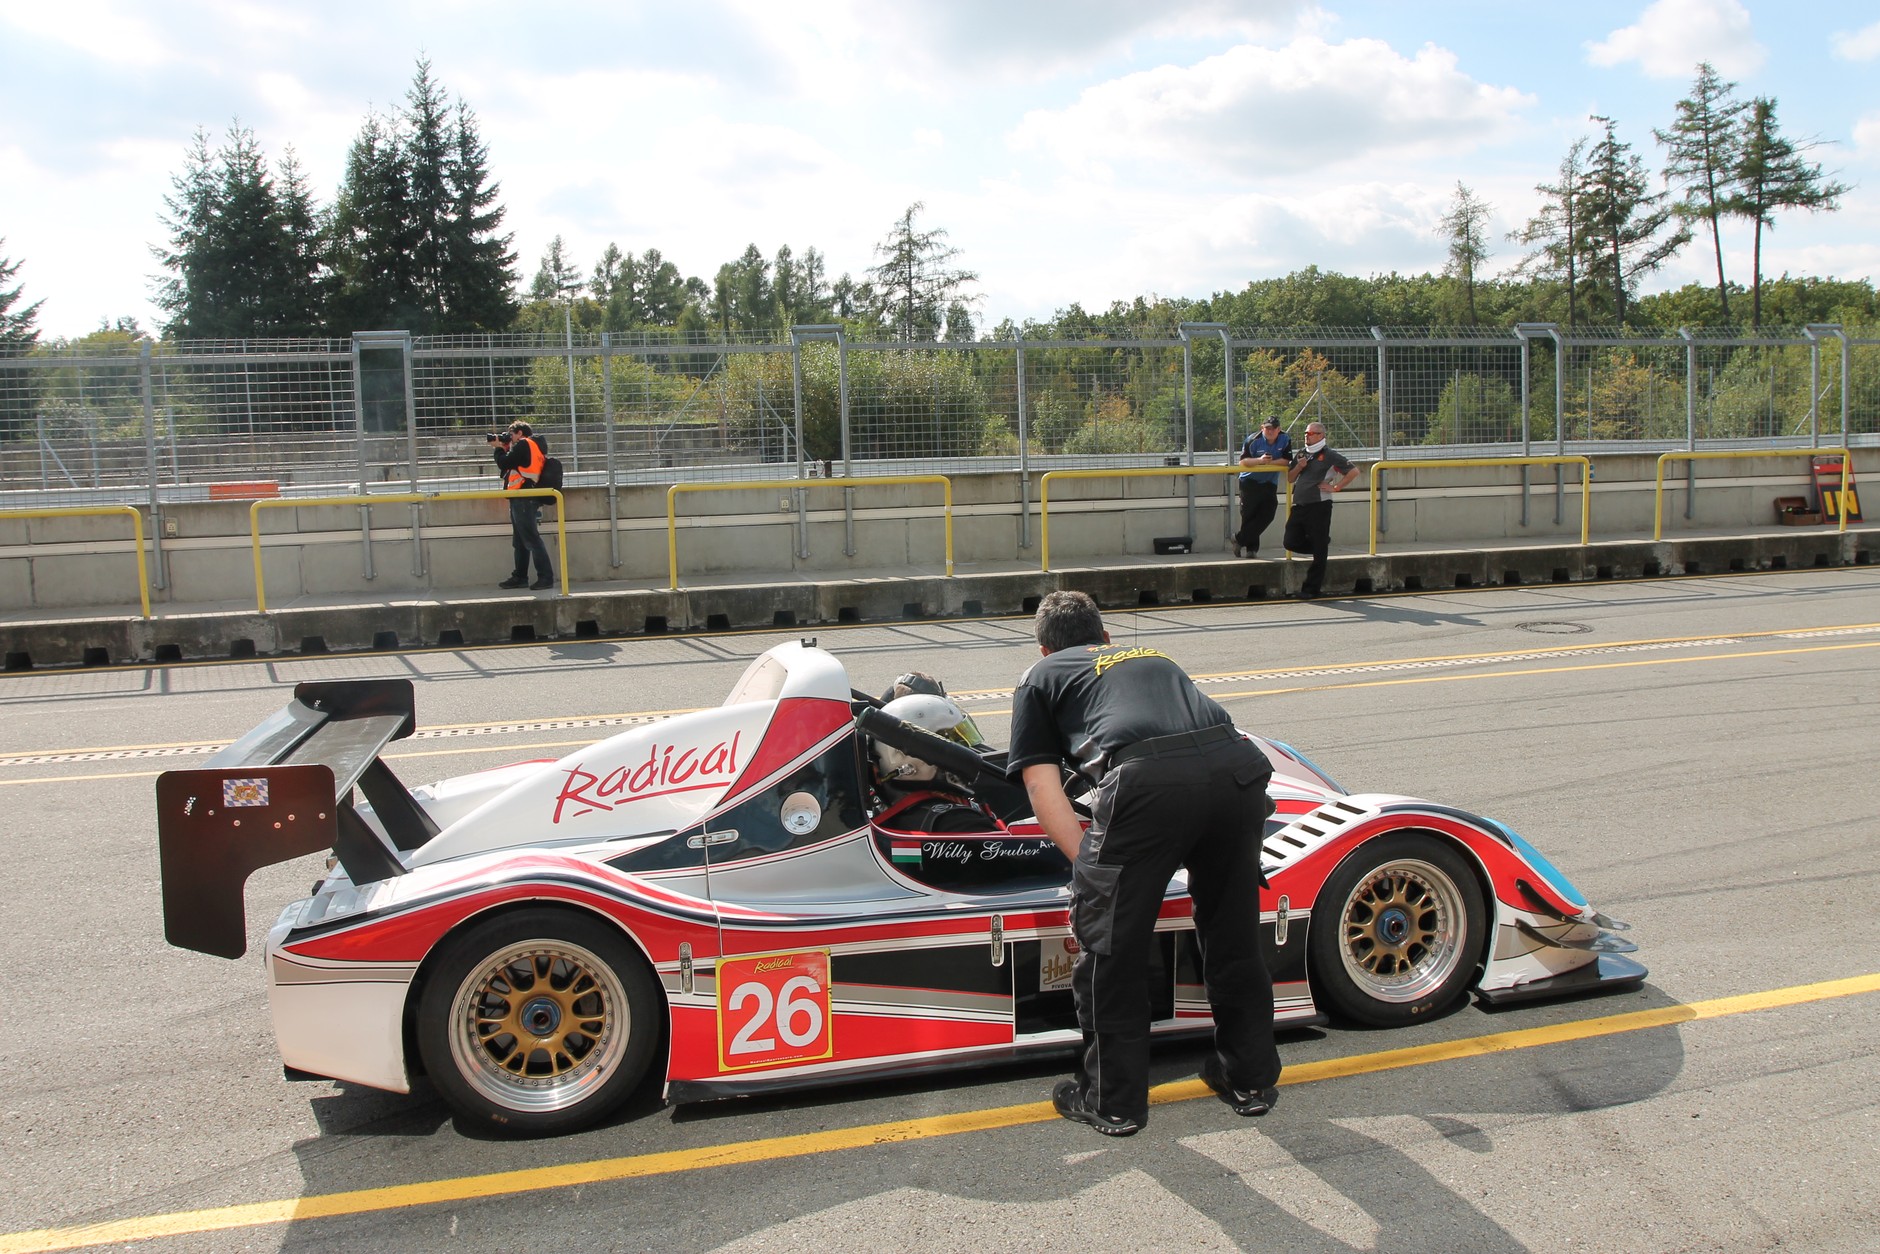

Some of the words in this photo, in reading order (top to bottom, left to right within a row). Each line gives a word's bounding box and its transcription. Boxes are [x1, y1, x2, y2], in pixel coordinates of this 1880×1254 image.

[1823, 490, 1859, 516] IN
[1092, 647, 1167, 676] Radic
[553, 730, 741, 824] Radical
[922, 840, 973, 864] Willy
[979, 840, 1040, 861] Gruber
[753, 956, 794, 974] Radical
[1042, 954, 1074, 984] Hub
[728, 975, 823, 1055] 26
